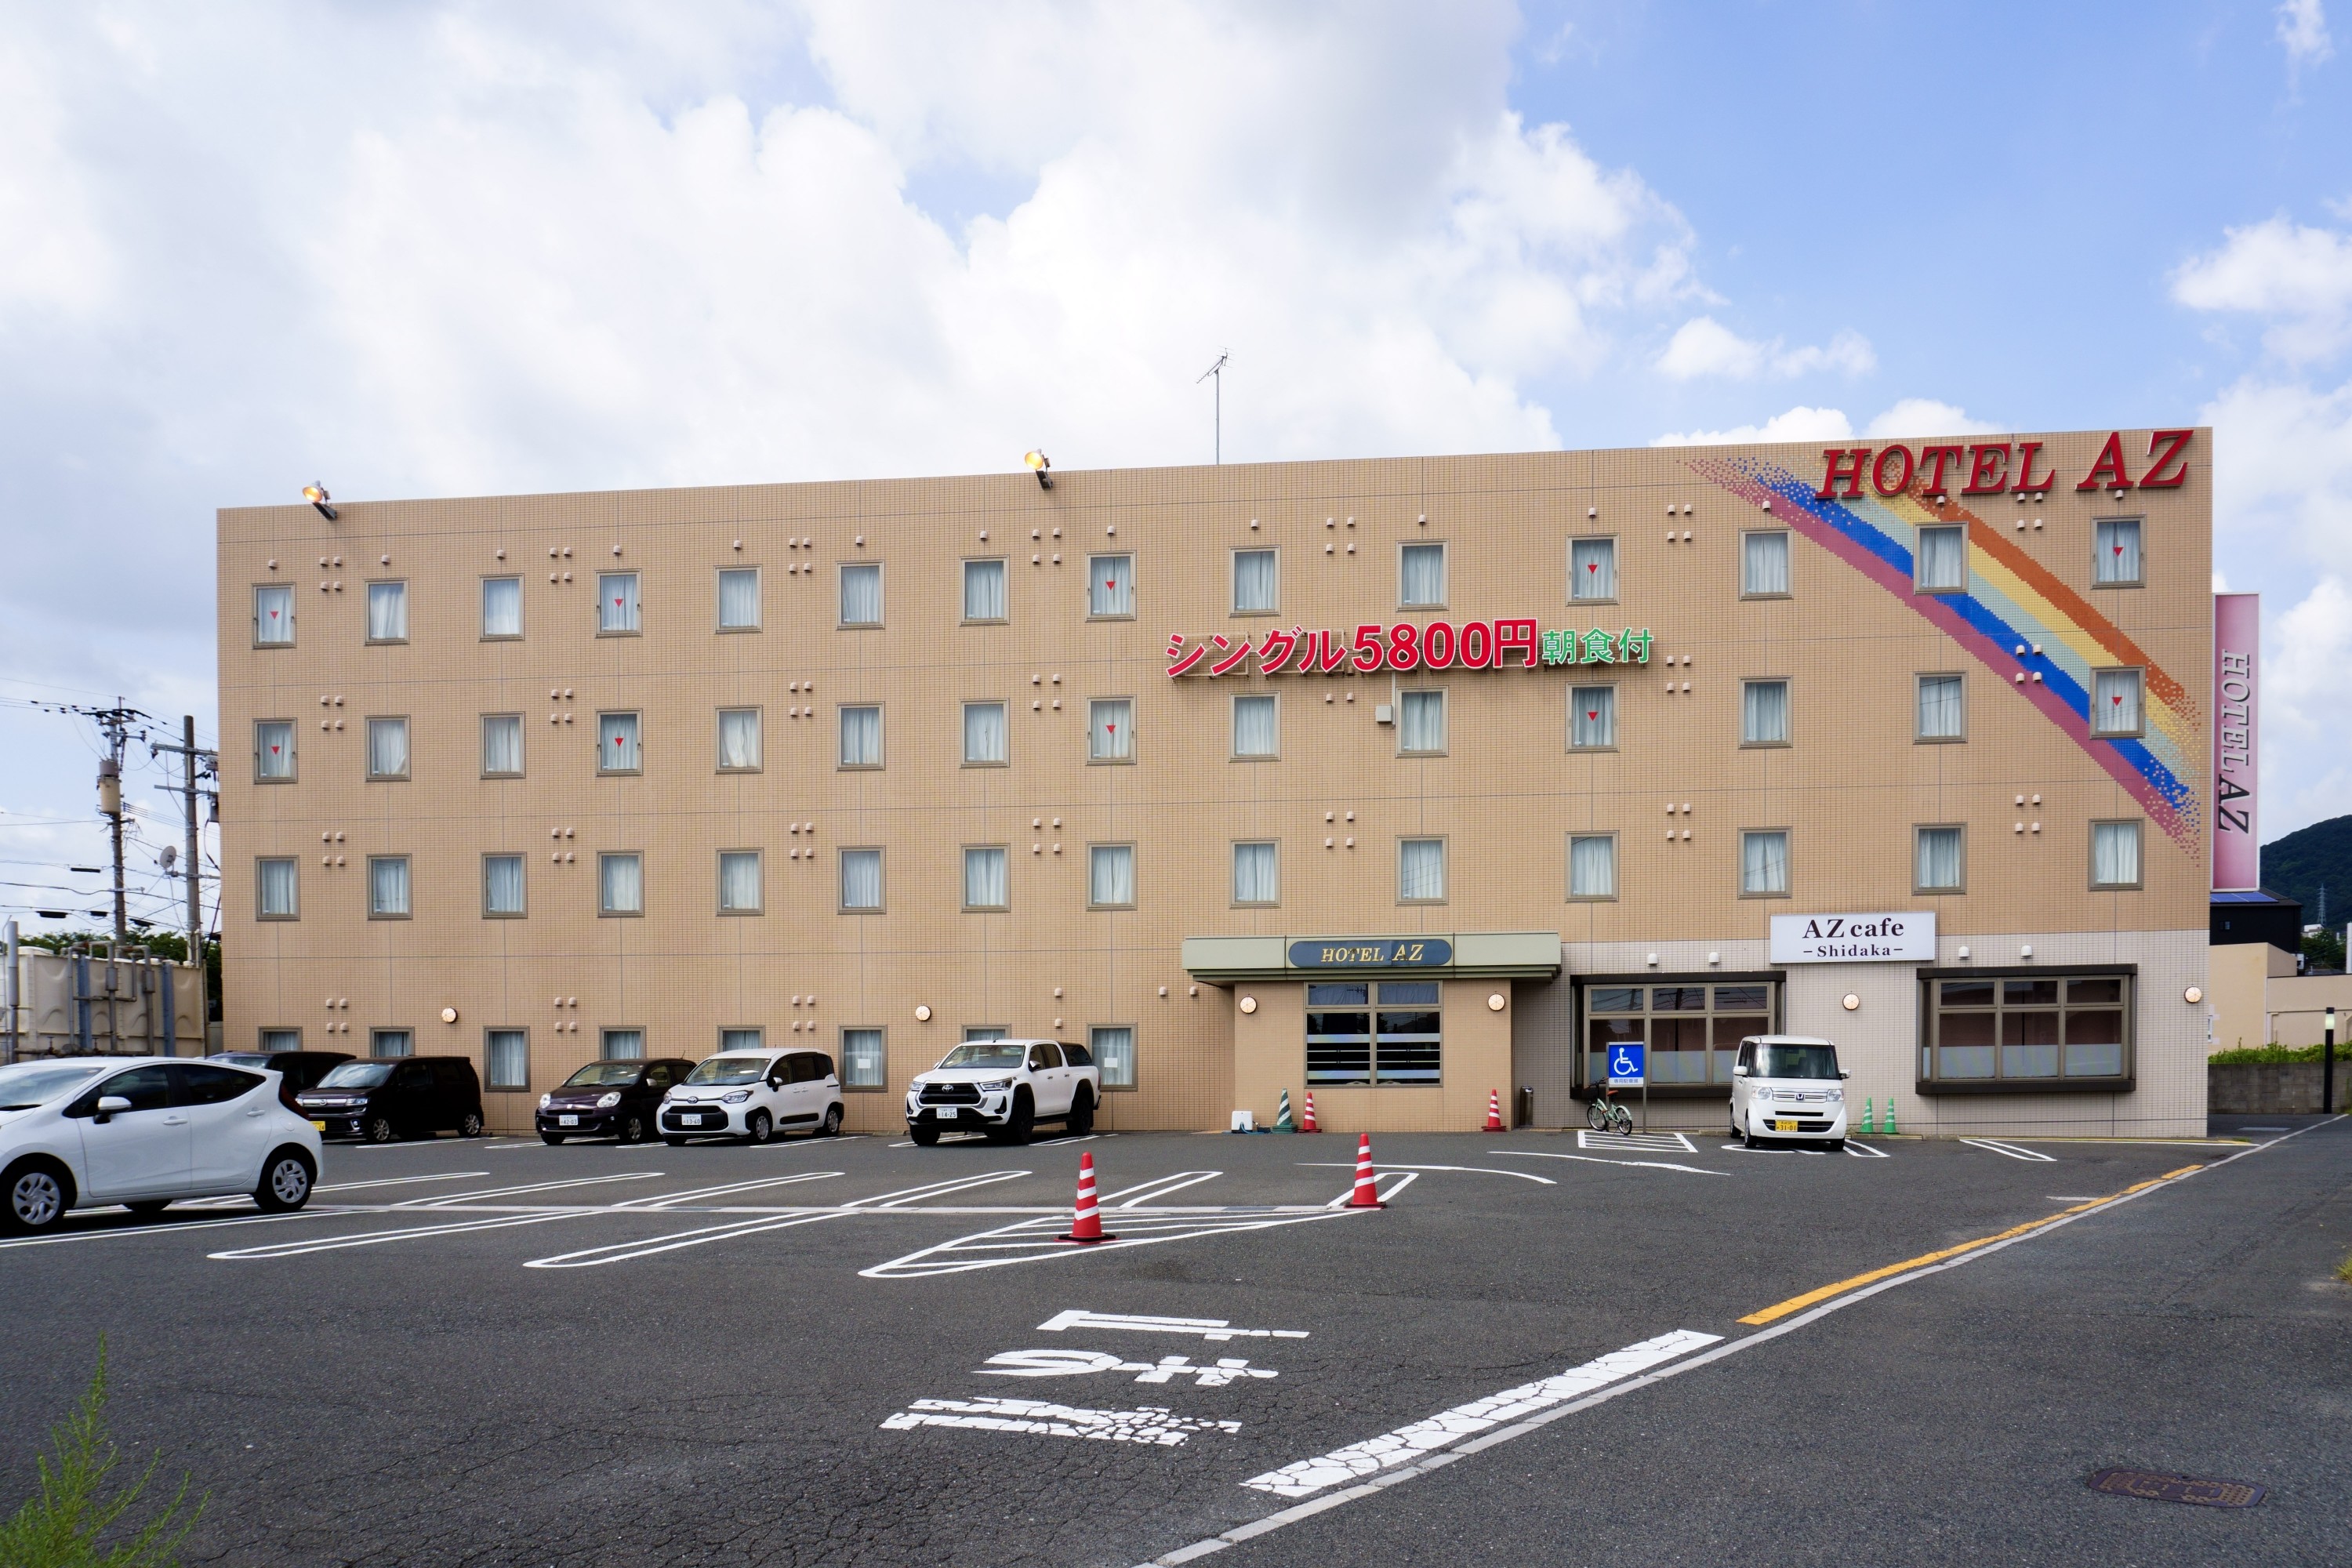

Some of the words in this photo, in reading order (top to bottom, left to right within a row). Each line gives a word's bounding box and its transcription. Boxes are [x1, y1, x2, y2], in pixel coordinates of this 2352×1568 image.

[1815, 441, 2056, 499] HOTEL
[2075, 430, 2194, 490] AZ
[2221, 649, 2250, 773] HOTEL
[2218, 774, 2252, 833] AZ
[1320, 947, 1384, 963] HOTEL
[1392, 944, 1425, 962] AZ
[1850, 917, 1904, 938] cafe
